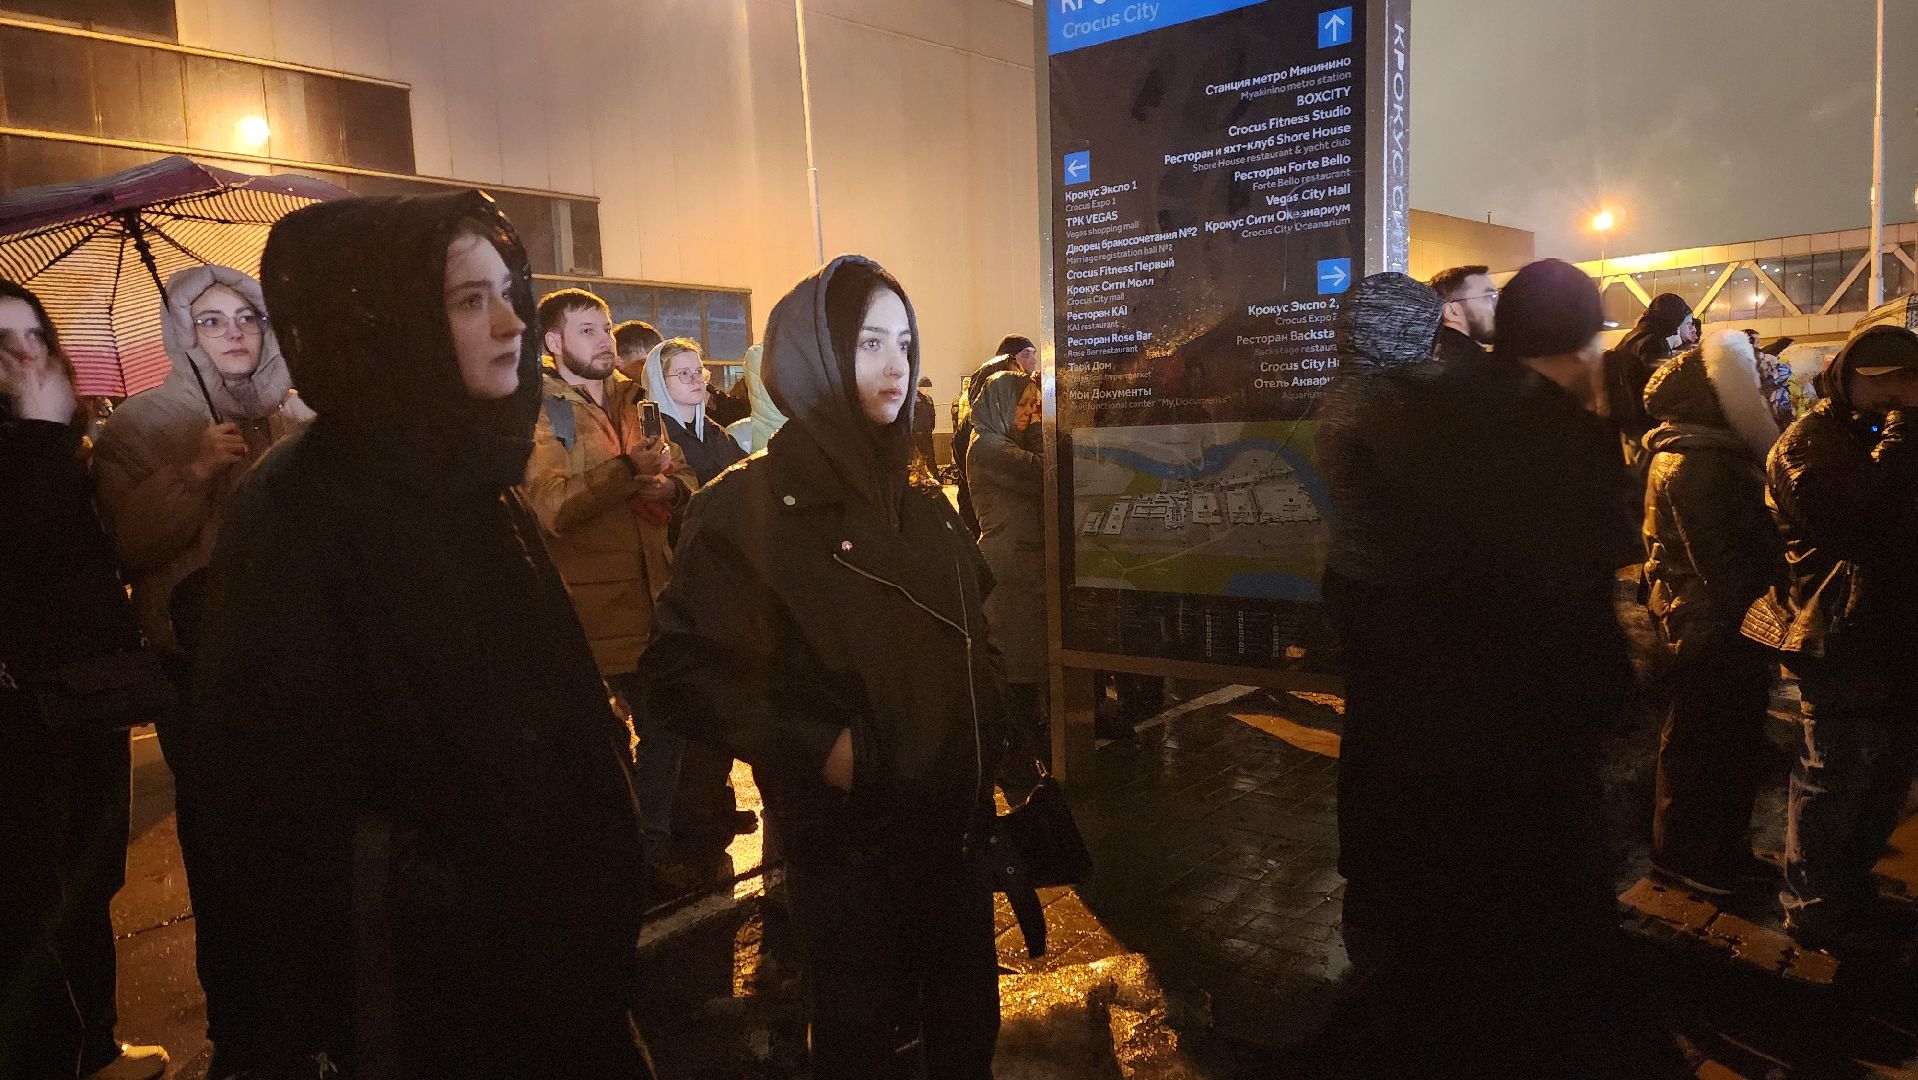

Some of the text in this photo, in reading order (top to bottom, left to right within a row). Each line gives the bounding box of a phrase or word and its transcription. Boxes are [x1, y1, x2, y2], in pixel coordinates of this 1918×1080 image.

[1063, 12, 1120, 39] Crocus
[1124, 2, 1159, 23] City
[1205, 57, 1351, 96] Станция метро Мякинино
[1241, 71, 1351, 101] Myakinino metro station
[1296, 85, 1352, 106] BOXCITY
[1393, 23, 1405, 175] КРОКУС
[1228, 104, 1352, 137] Crocus Fitness Studio
[1164, 123, 1351, 166] Ресторан и яхт-клуб Shore House
[1192, 138, 1351, 173] Shore House restaurant & yacht club
[1234, 153, 1351, 182] Ресторан Forte Bello
[1065, 180, 1138, 202] Крокус Экспо 1
[1252, 169, 1351, 192] Forte Bello restaurant
[1065, 201, 1090, 212] Crocus
[1092, 198, 1111, 208] Expo
[1266, 183, 1351, 207] Vegas City Hall
[1065, 210, 1119, 228] ТРК VEGAS
[1204, 203, 1351, 234] Крокус Сити Океанариум
[1242, 217, 1351, 239] Crocus City Oceanarium
[1066, 221, 1139, 240] Vegas shopping mall
[1066, 226, 1198, 256] Дворец бракосочетания №2
[1066, 253, 1098, 265] Marriage
[1099, 248, 1143, 262] registration
[1144, 245, 1158, 254] hall
[1066, 257, 1175, 280] Crocus Fitness Первый
[1066, 277, 1154, 296] Крокус Сити Молл
[1066, 292, 1125, 306] Crocus City mall
[1248, 304, 1290, 317] Крокус
[1291, 300, 1327, 312] Экспо
[1066, 309, 1110, 321] Ресторан
[1275, 315, 1308, 325] Crocus
[1308, 313, 1332, 324] Expo
[1067, 330, 1152, 348] Ресторан Rose Bar
[1236, 328, 1335, 345] Ресторан Backsta
[1068, 361, 1112, 373] Твой Дом
[1260, 361, 1299, 372] Crocus
[1302, 358, 1325, 371] City
[1254, 376, 1336, 389] Отель Аквар
[1069, 386, 1152, 401] Мои Документы
